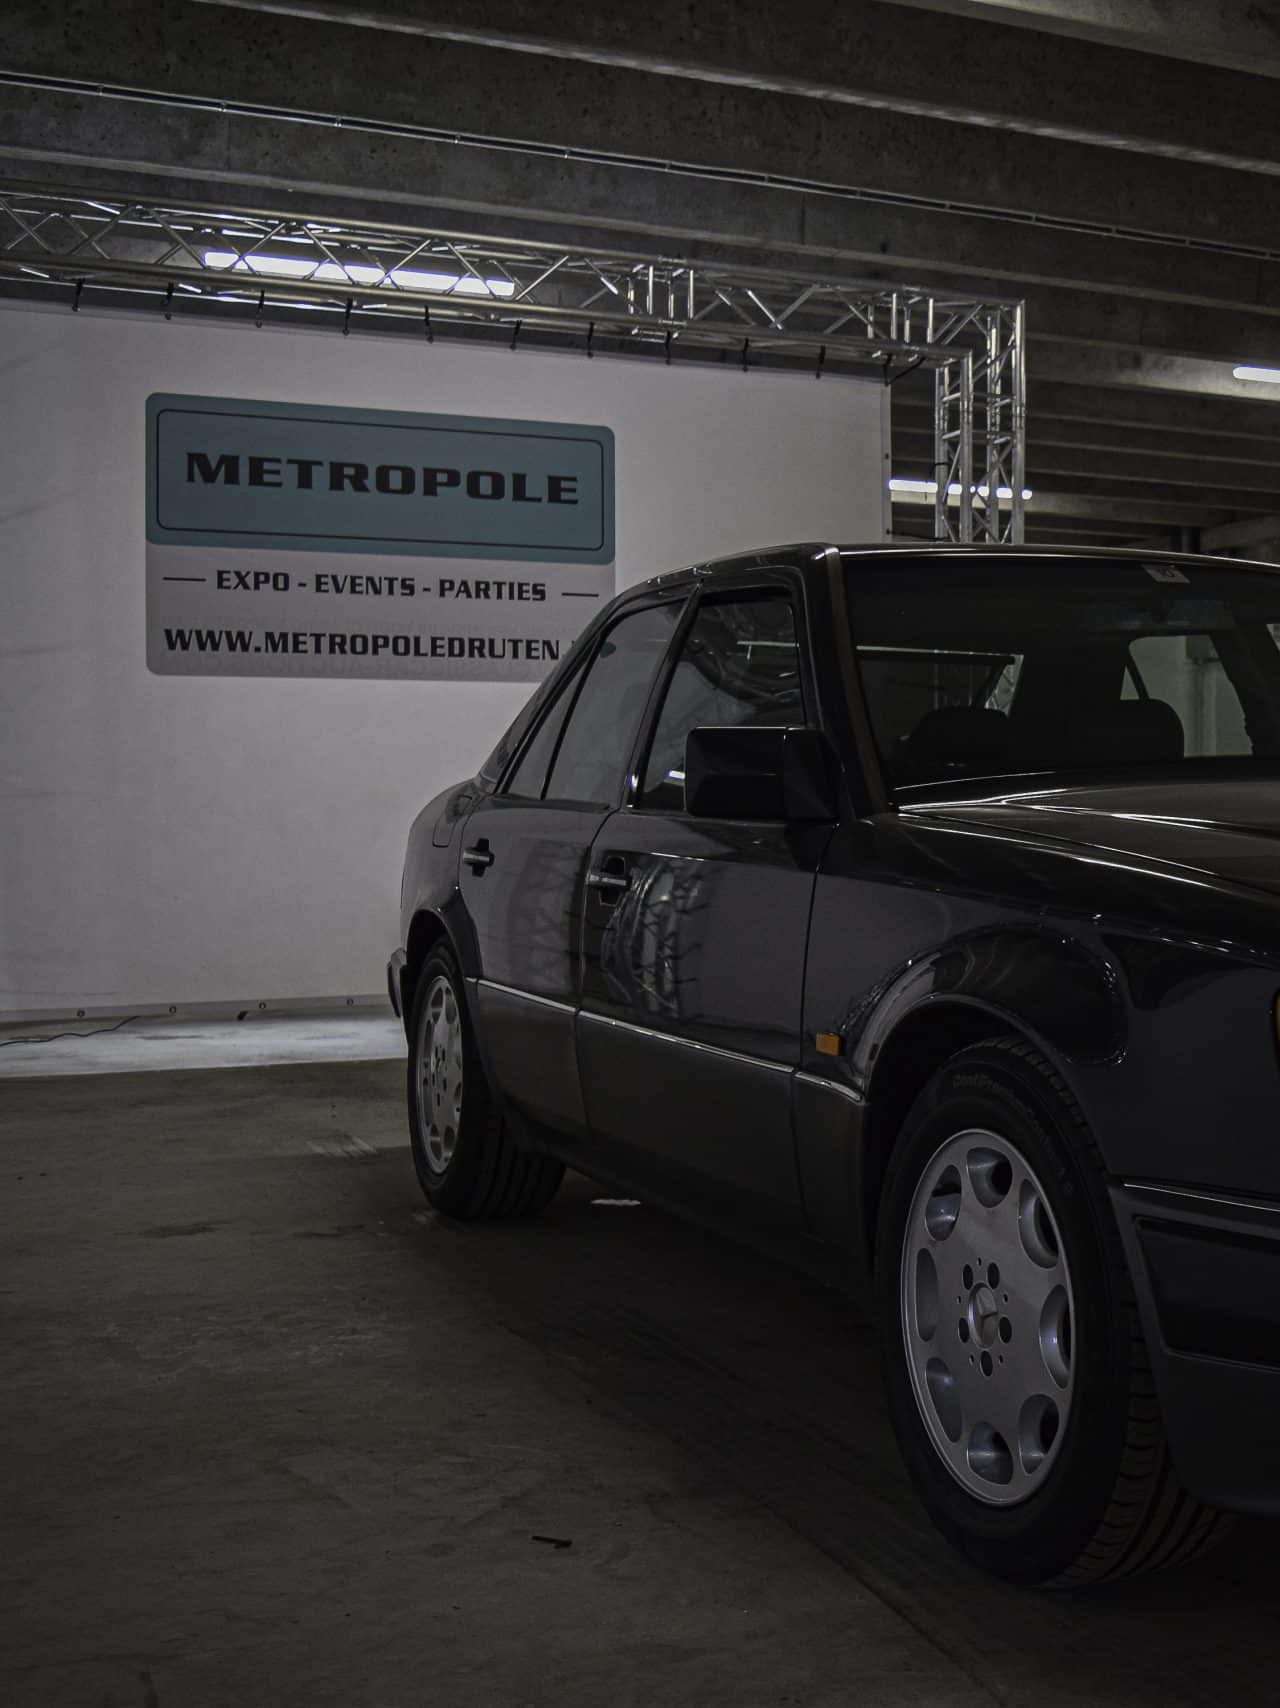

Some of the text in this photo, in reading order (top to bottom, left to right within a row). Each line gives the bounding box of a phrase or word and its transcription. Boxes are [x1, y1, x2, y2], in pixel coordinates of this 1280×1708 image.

[185, 450, 580, 505] METROPOLE
[215, 569, 290, 592] EXPO
[314, 573, 416, 597] EVENTS
[438, 578, 547, 602] PARTIES
[163, 628, 574, 661] WWW.METROPOLEDRUTEN
